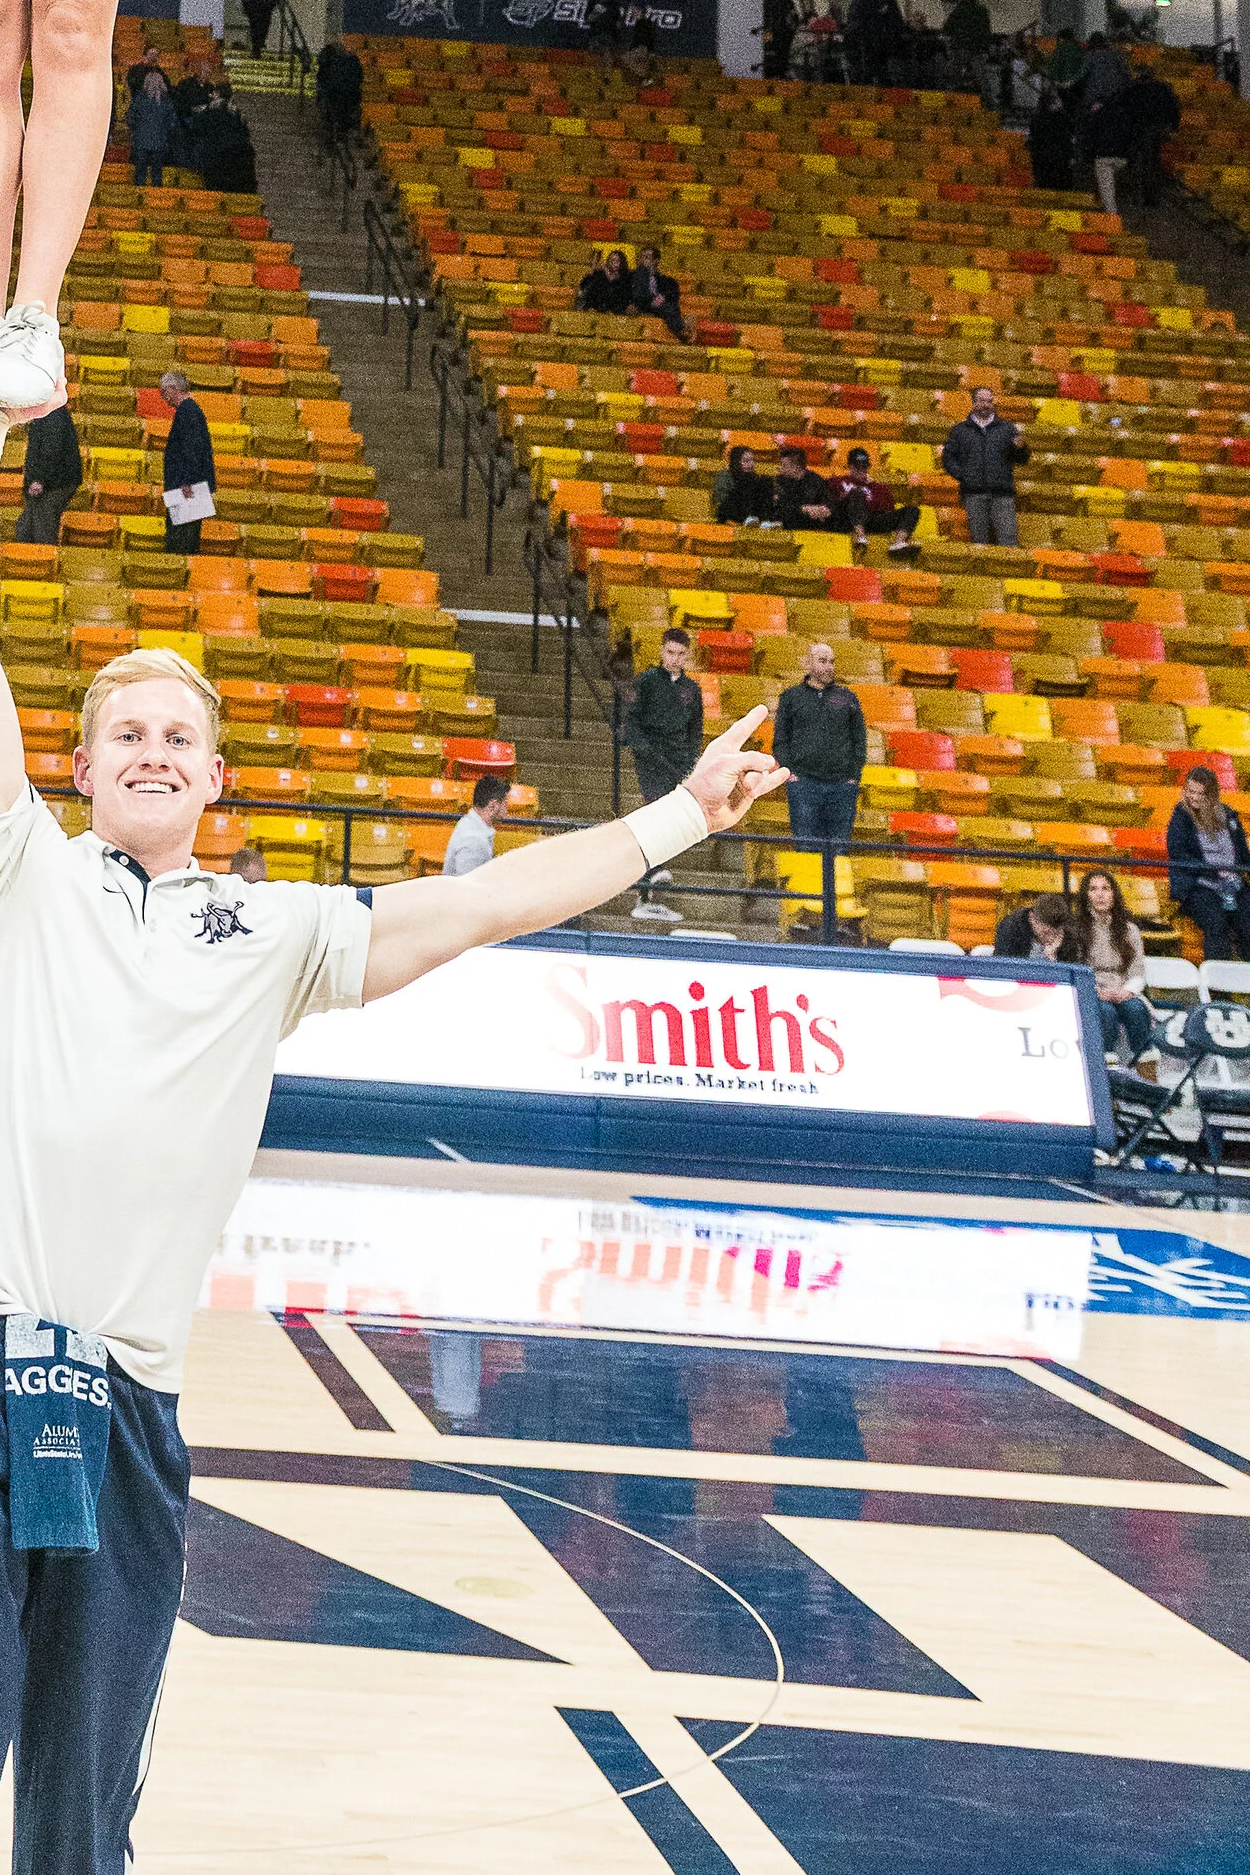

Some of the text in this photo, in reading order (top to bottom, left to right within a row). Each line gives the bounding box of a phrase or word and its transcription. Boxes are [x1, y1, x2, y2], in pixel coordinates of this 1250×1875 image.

[545, 961, 845, 1076] Smith's
[1017, 1027, 1082, 1059] Lo
[694, 1073, 765, 1092] Market
[41, 1423, 79, 1438] ALUM
